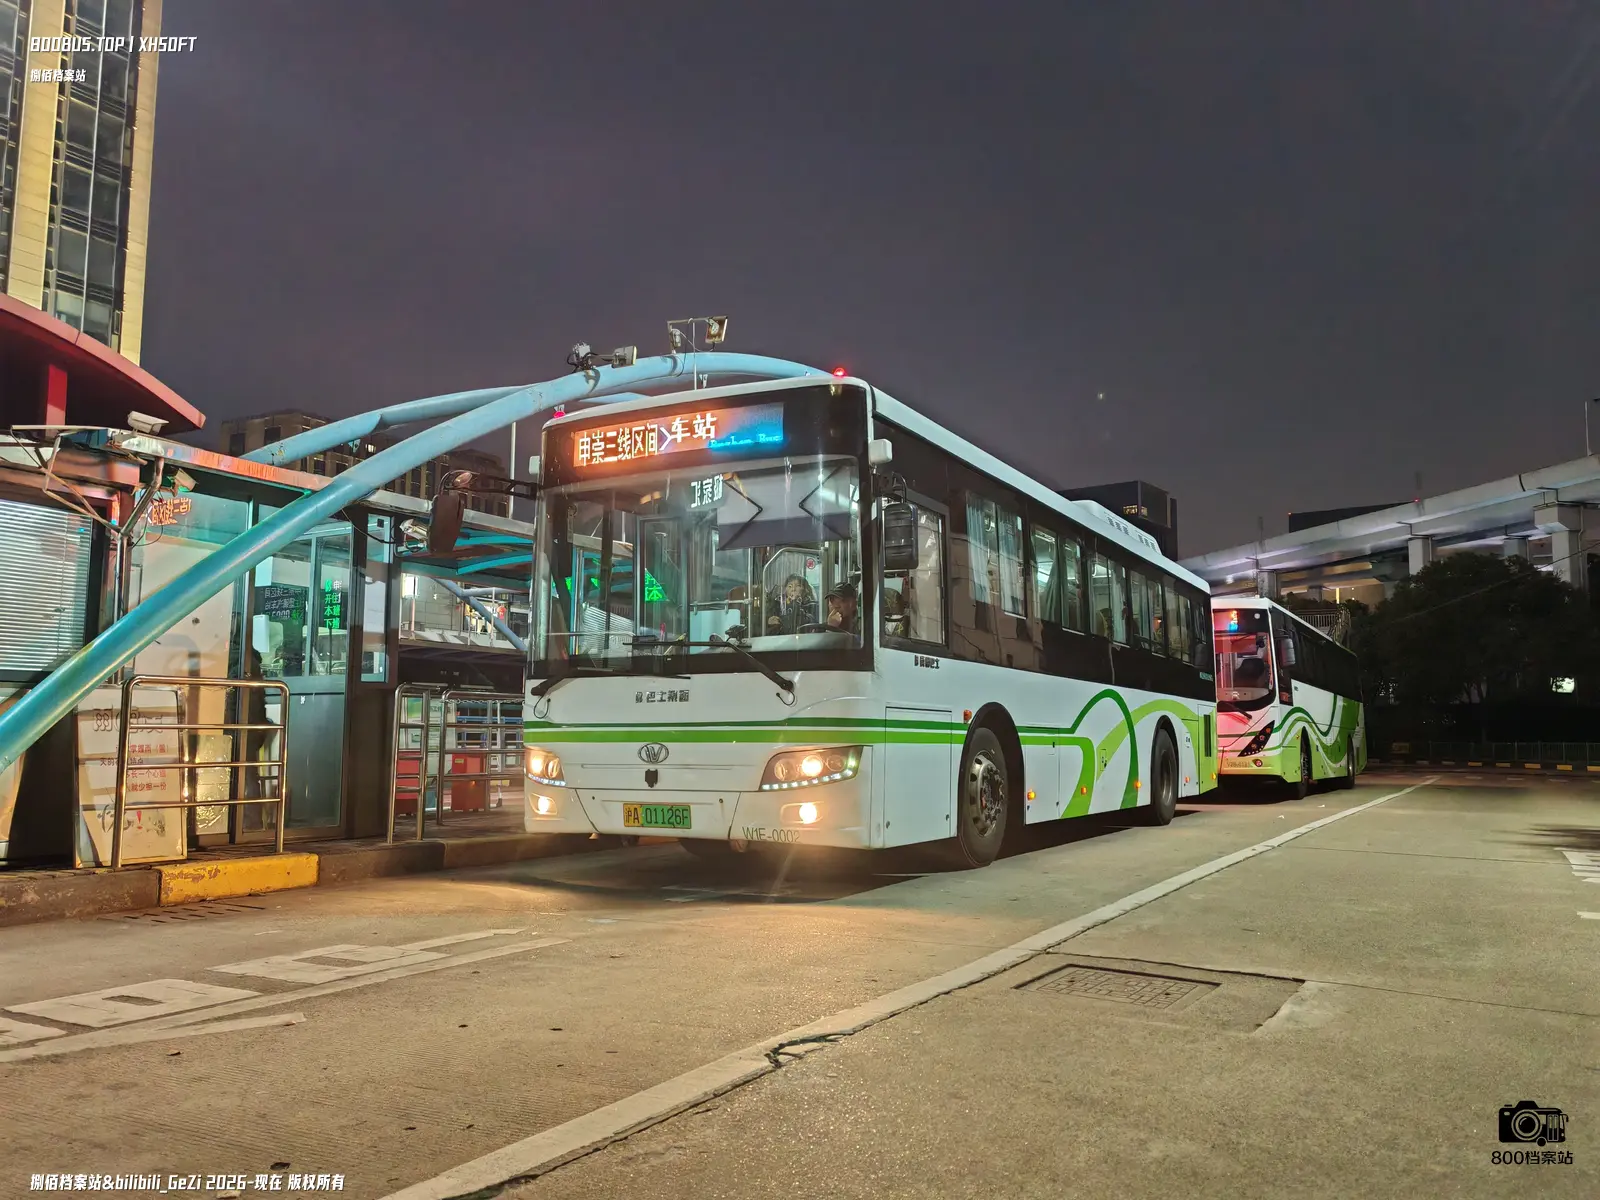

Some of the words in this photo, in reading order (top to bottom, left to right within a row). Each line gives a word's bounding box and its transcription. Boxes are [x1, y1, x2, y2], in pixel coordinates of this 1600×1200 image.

[579, 423, 658, 466] 申崇三线区间
[671, 413, 717, 443] 车站
[741, 826, 800, 843] W1E-0002
